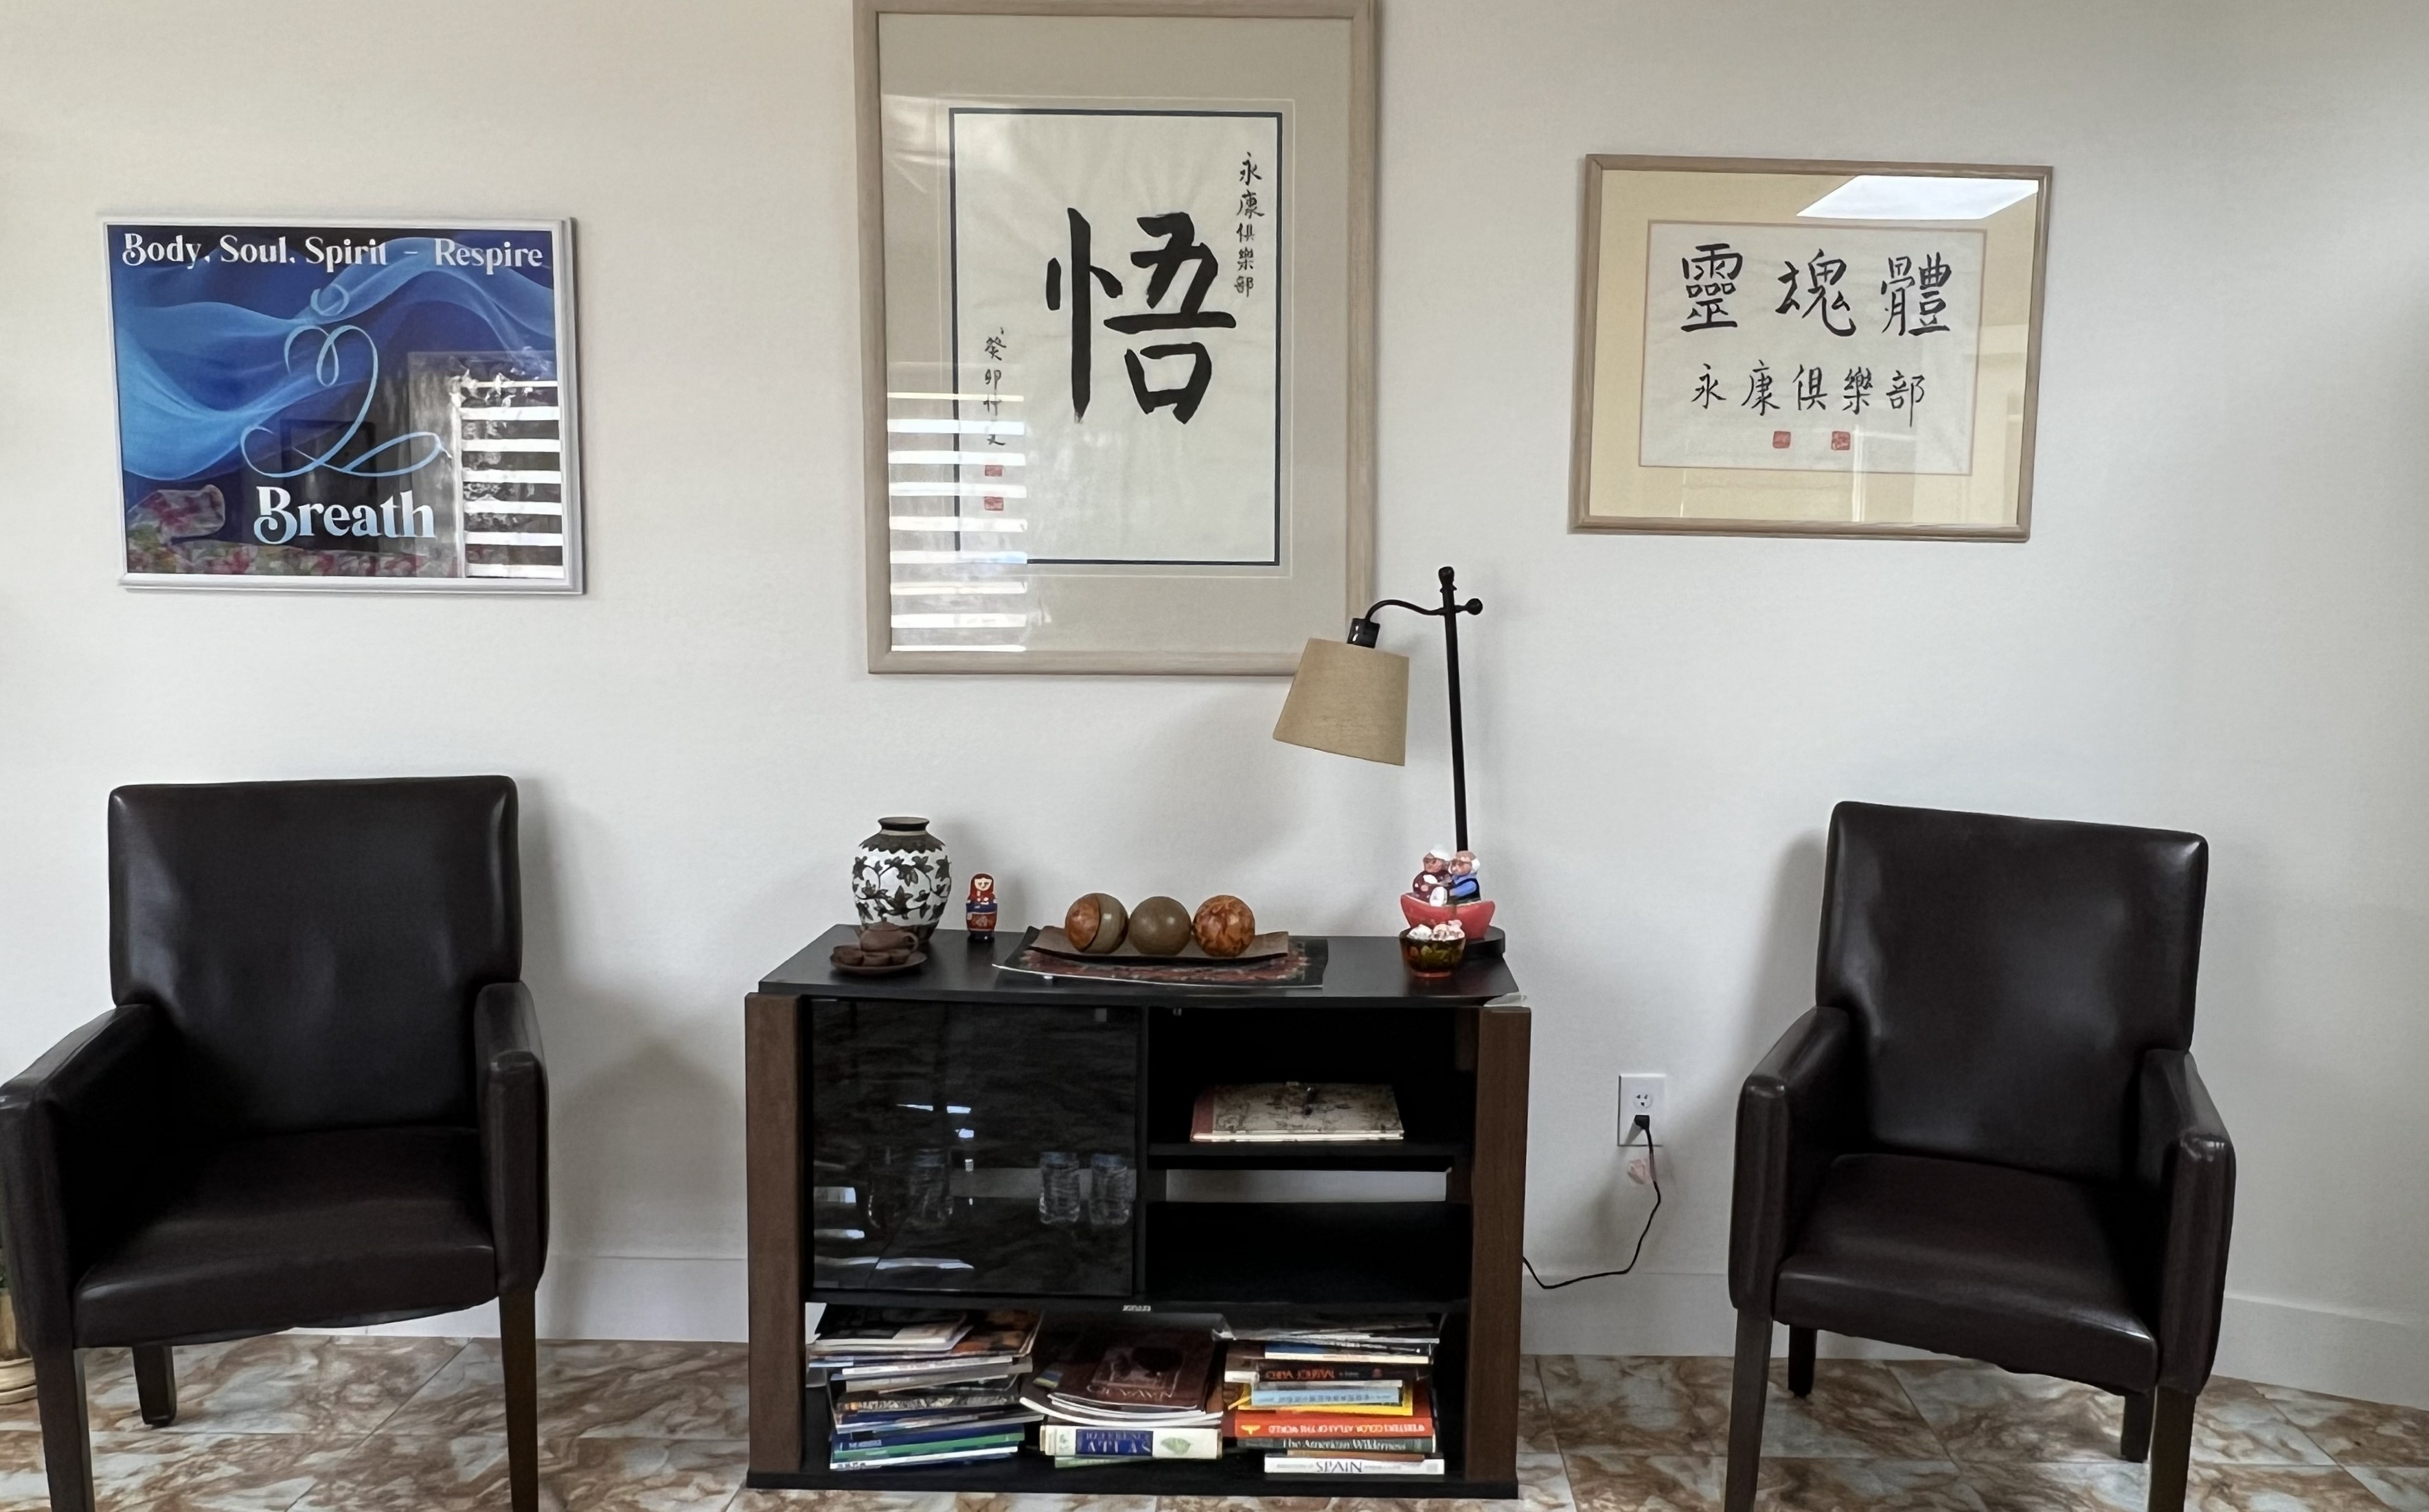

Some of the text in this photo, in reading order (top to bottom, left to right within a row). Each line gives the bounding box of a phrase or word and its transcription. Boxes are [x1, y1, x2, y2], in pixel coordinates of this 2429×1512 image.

[305, 236, 388, 273] Spirit
[433, 238, 543, 275] Respire
[1045, 207, 1237, 424] 悟
[1680, 242, 1952, 338] 靈魂體
[1691, 359, 1926, 428] 永康俱樂部
[253, 485, 437, 545] Breath
[1316, 1461, 1362, 1473] SPAIN
